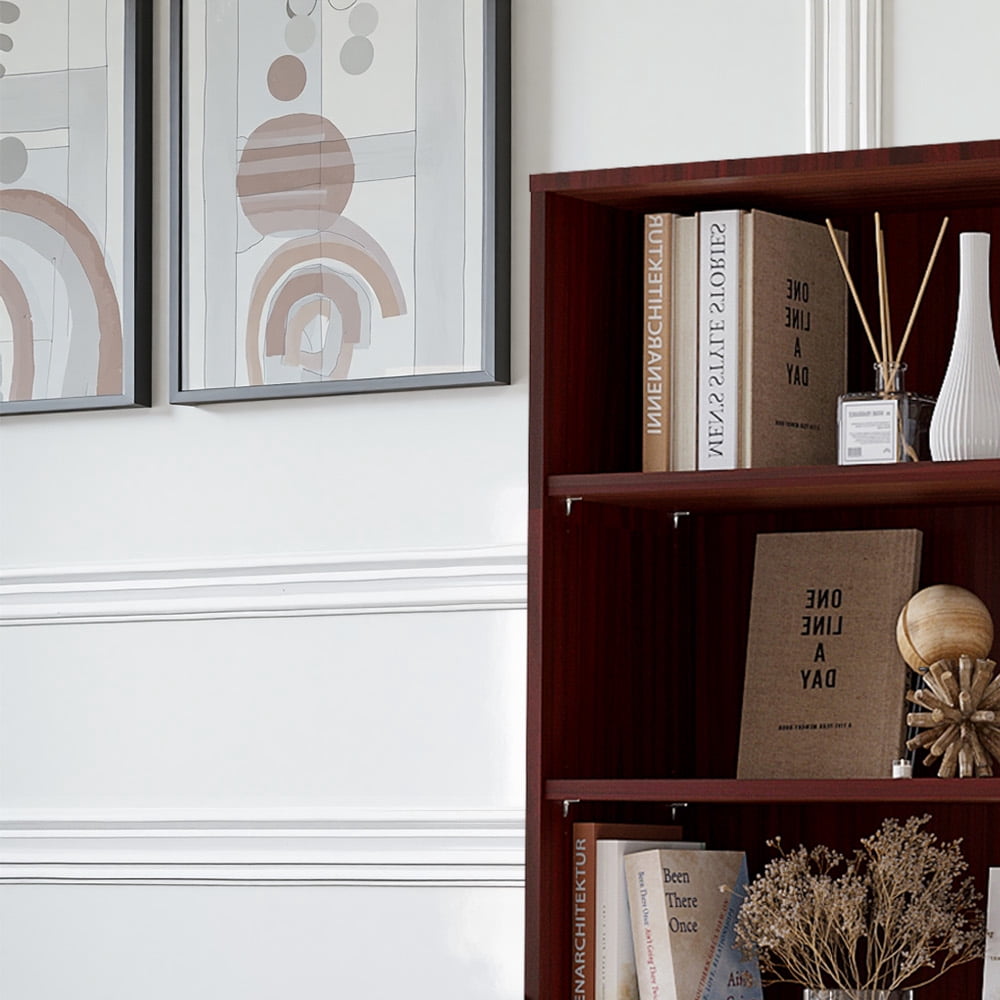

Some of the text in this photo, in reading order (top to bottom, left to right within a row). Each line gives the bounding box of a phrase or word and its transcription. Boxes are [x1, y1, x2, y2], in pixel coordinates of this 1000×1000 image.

[663, 868, 690, 884] Been
[666, 893, 698, 909] There
[668, 918, 698, 934] Once
